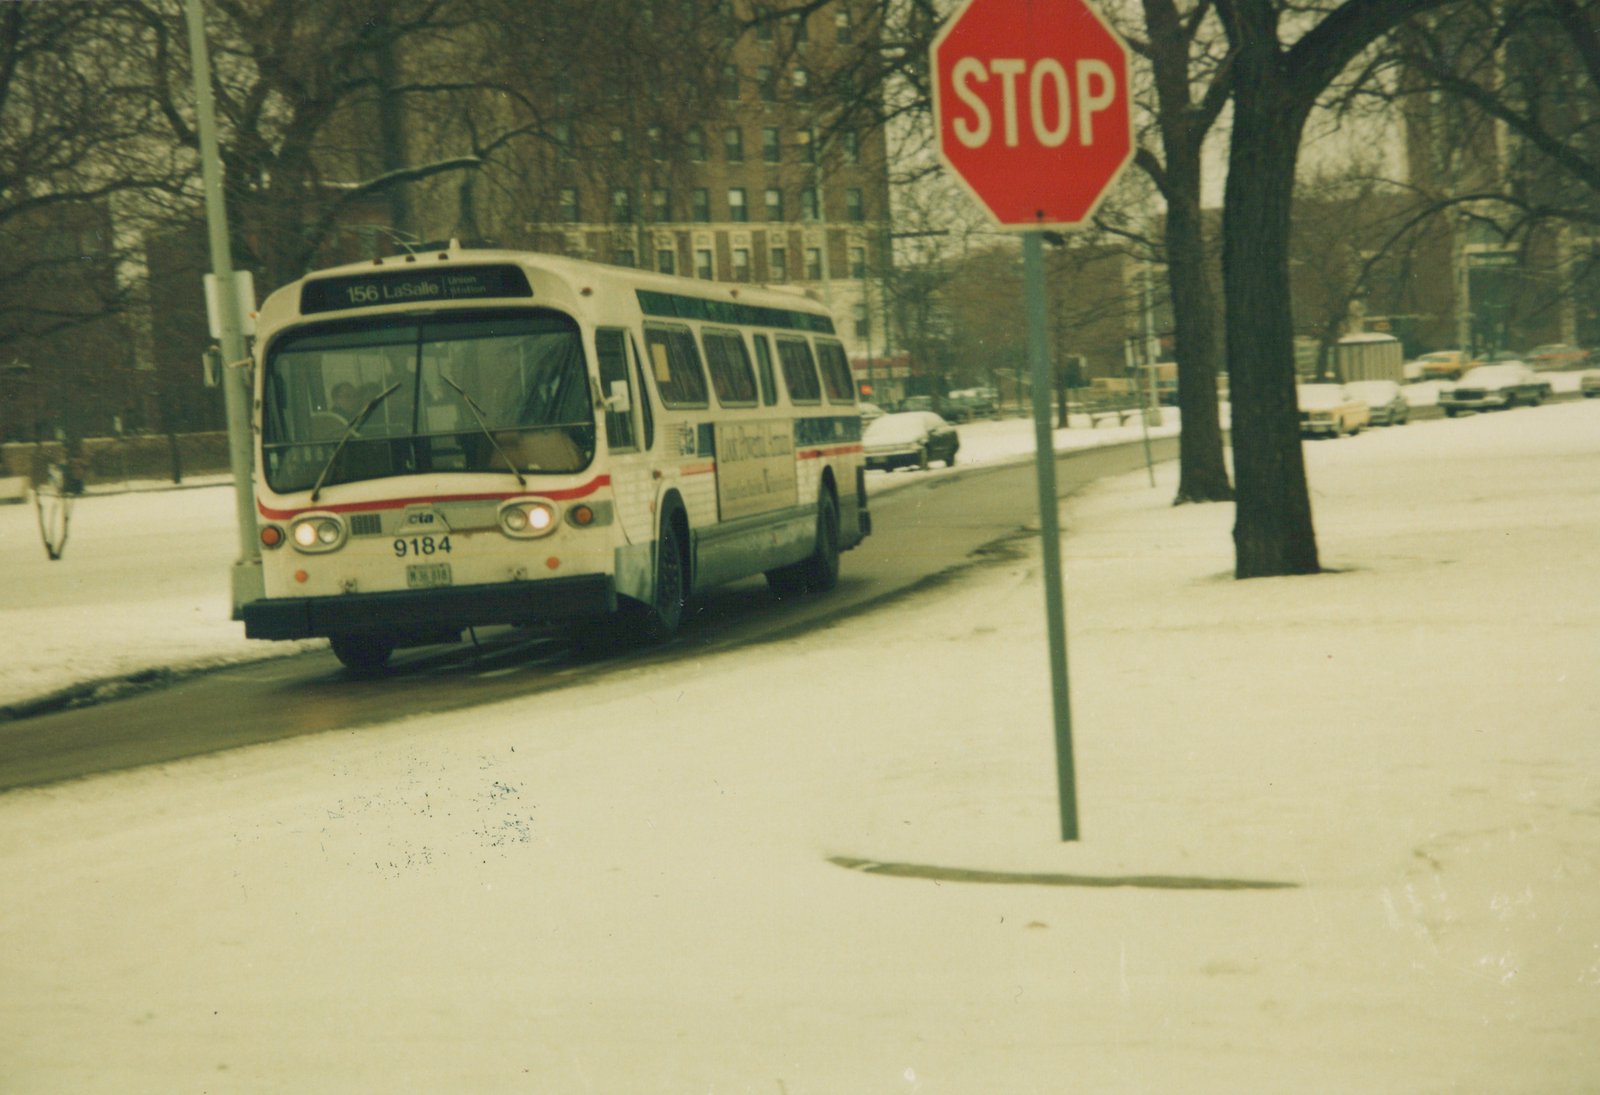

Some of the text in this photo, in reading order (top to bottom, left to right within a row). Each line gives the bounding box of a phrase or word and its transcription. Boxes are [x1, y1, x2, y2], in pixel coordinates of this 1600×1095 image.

[952, 56, 1116, 148] STOP
[347, 281, 439, 302] 156 LaSalle
[408, 512, 434, 524] cta
[393, 536, 451, 557] 9184
